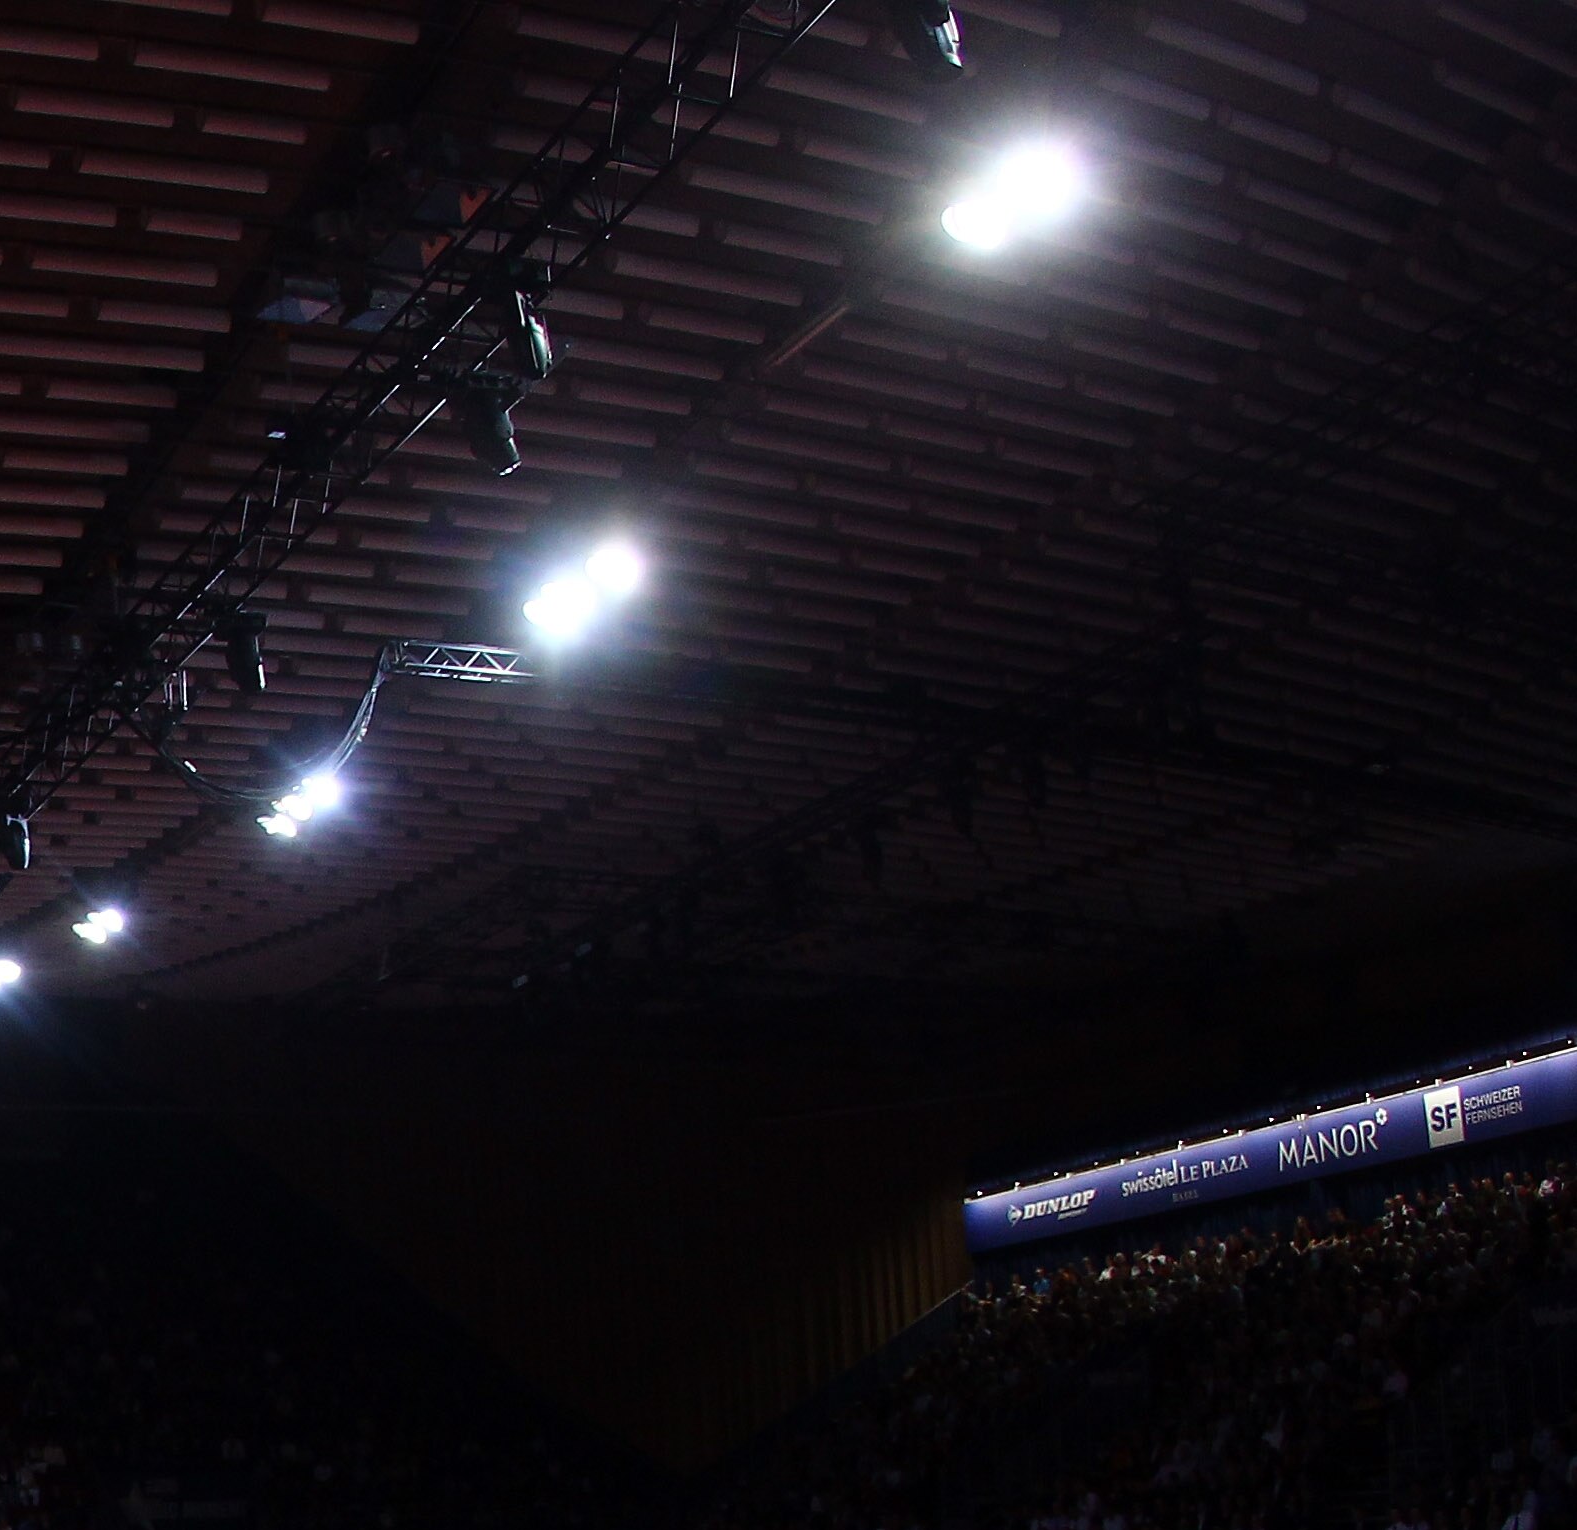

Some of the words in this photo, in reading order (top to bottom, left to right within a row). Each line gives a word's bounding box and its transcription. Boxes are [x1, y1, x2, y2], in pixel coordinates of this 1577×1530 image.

[1465, 1085, 1521, 1110] SCHWEIZER
[1431, 1103, 1457, 1132] SF
[1465, 1101, 1523, 1126] FERNSEHEN
[1279, 1119, 1378, 1172] MANOR
[1121, 1160, 1179, 1197] swissôtel
[1180, 1165, 1199, 1183] LE
[1201, 1154, 1248, 1179] PLAZA
[1022, 1189, 1096, 1220] DUNLOP
